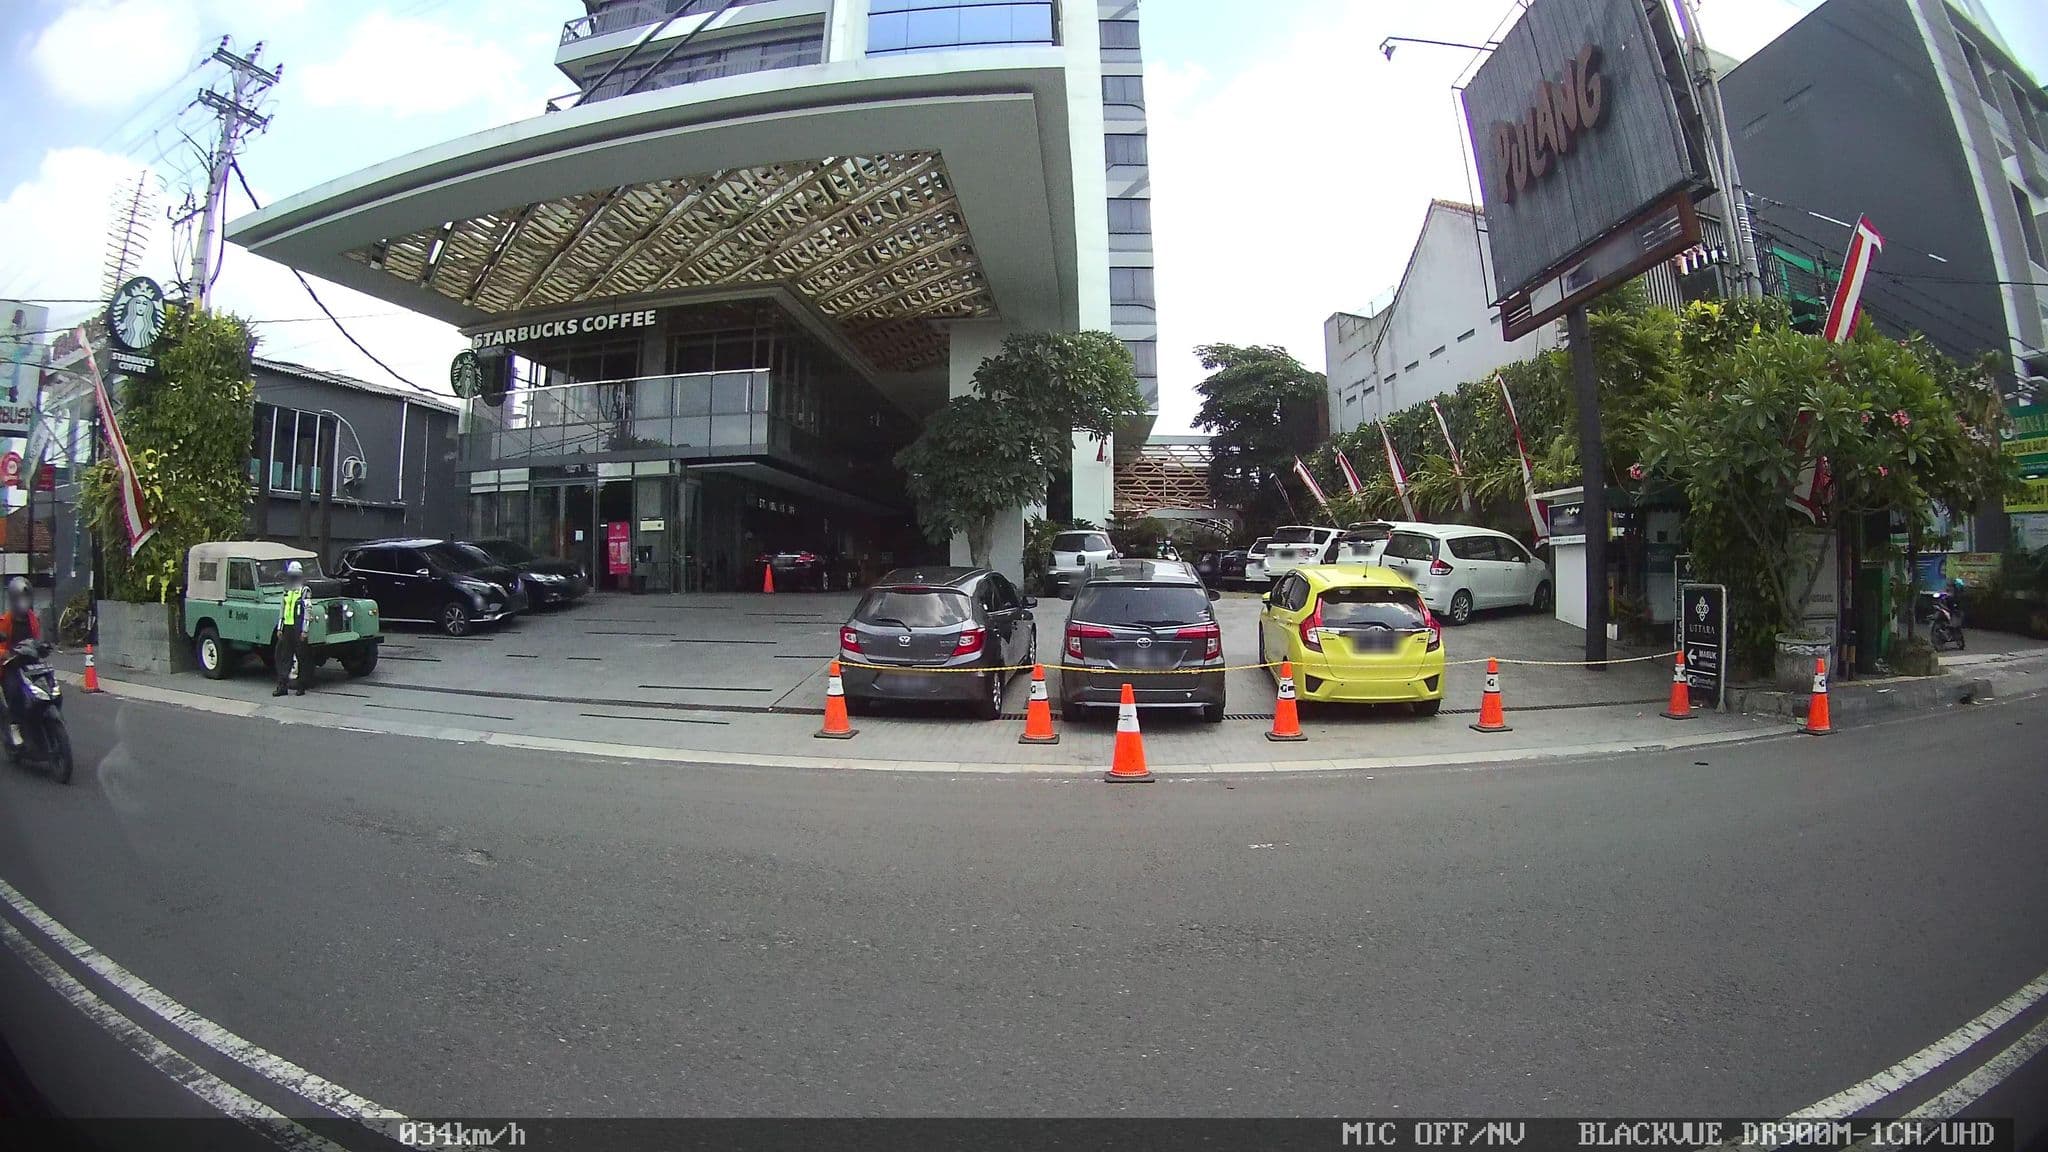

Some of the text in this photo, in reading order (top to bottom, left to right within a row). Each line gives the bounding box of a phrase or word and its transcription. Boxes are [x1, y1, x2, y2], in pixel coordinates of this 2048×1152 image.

[1492, 44, 1602, 204] PULANG
[472, 310, 657, 349] STARBUCKS COFFEE
[112, 352, 155, 367] STARBUCKS
[119, 361, 147, 374] COFFEE
[1689, 624, 1715, 635] UTTARA
